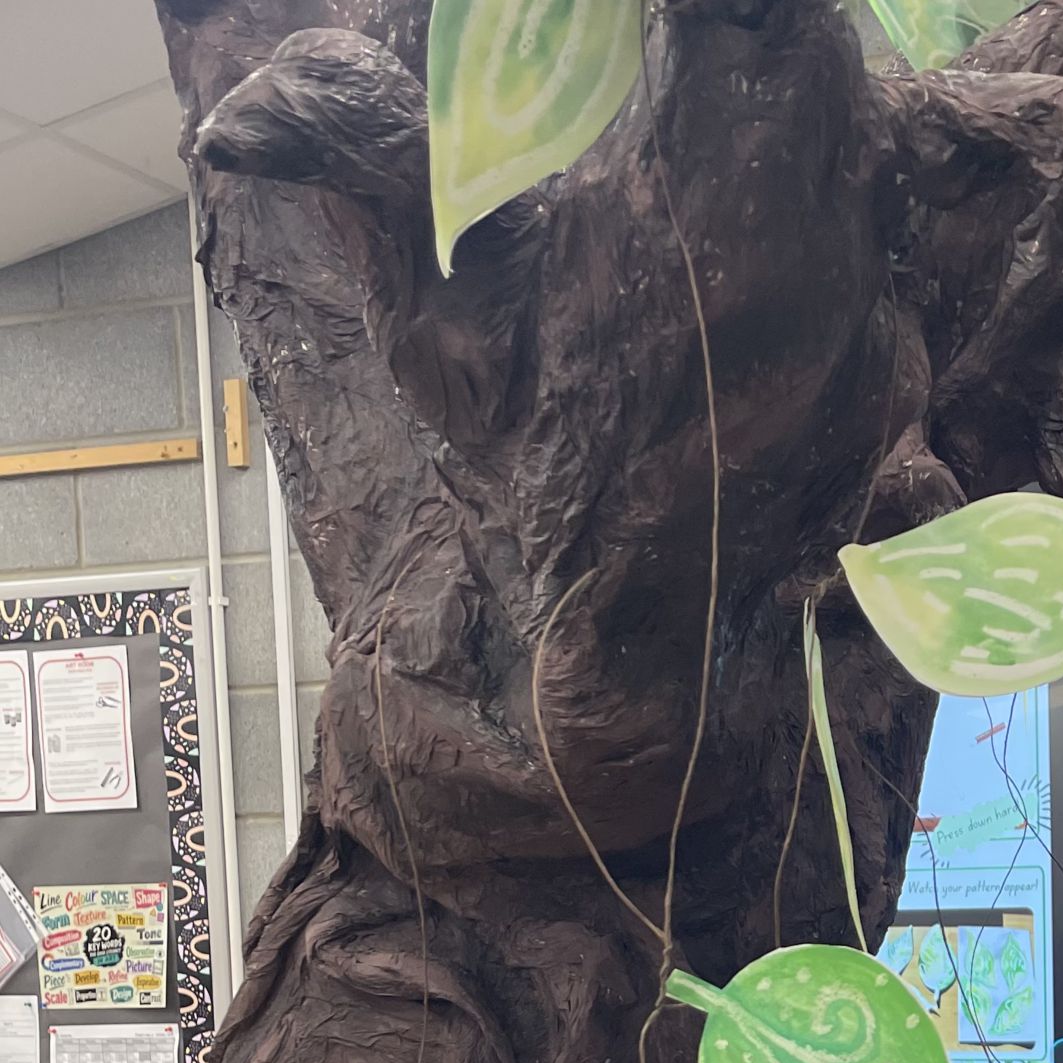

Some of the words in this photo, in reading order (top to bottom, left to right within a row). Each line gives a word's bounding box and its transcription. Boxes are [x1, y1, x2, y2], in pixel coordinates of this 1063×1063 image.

[936, 829, 963, 844] Press
[968, 815, 993, 832] down
[942, 884, 962, 898] your
[965, 880, 1001, 898] pattern
[40, 893, 61, 909] Line
[65, 890, 98, 912] Colour
[101, 891, 129, 905] SPACE
[117, 915, 144, 926] Pattern
[93, 926, 111, 940] 20
[137, 928, 161, 939] Tone
[88, 942, 100, 952] KEY
[101, 939, 122, 951] WORDS
[127, 961, 152, 972] Picture
[45, 991, 67, 1005] Scale
